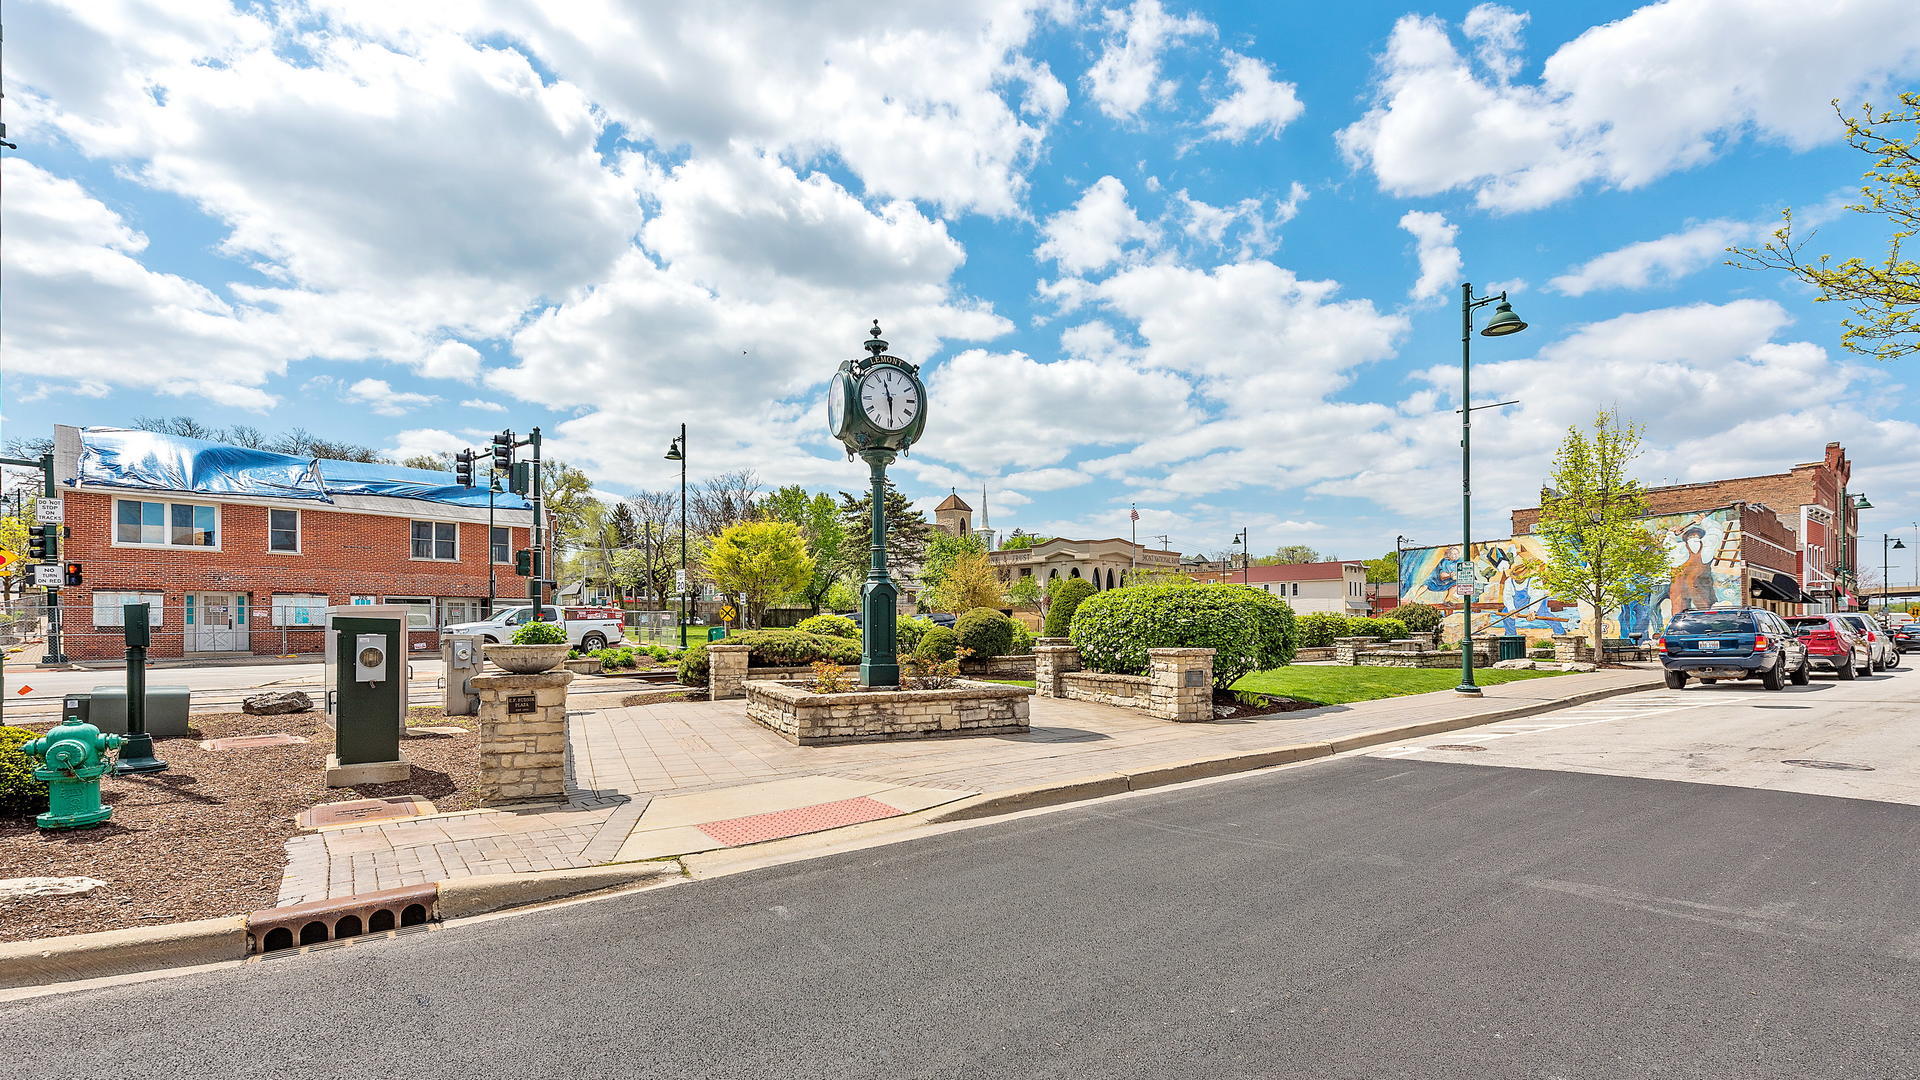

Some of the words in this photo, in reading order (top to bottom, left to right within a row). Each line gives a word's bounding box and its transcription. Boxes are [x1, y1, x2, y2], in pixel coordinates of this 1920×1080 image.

[870, 356, 904, 367] LEMONT
[1012, 553, 1031, 561] TRUST
[676, 581, 685, 590] 20
